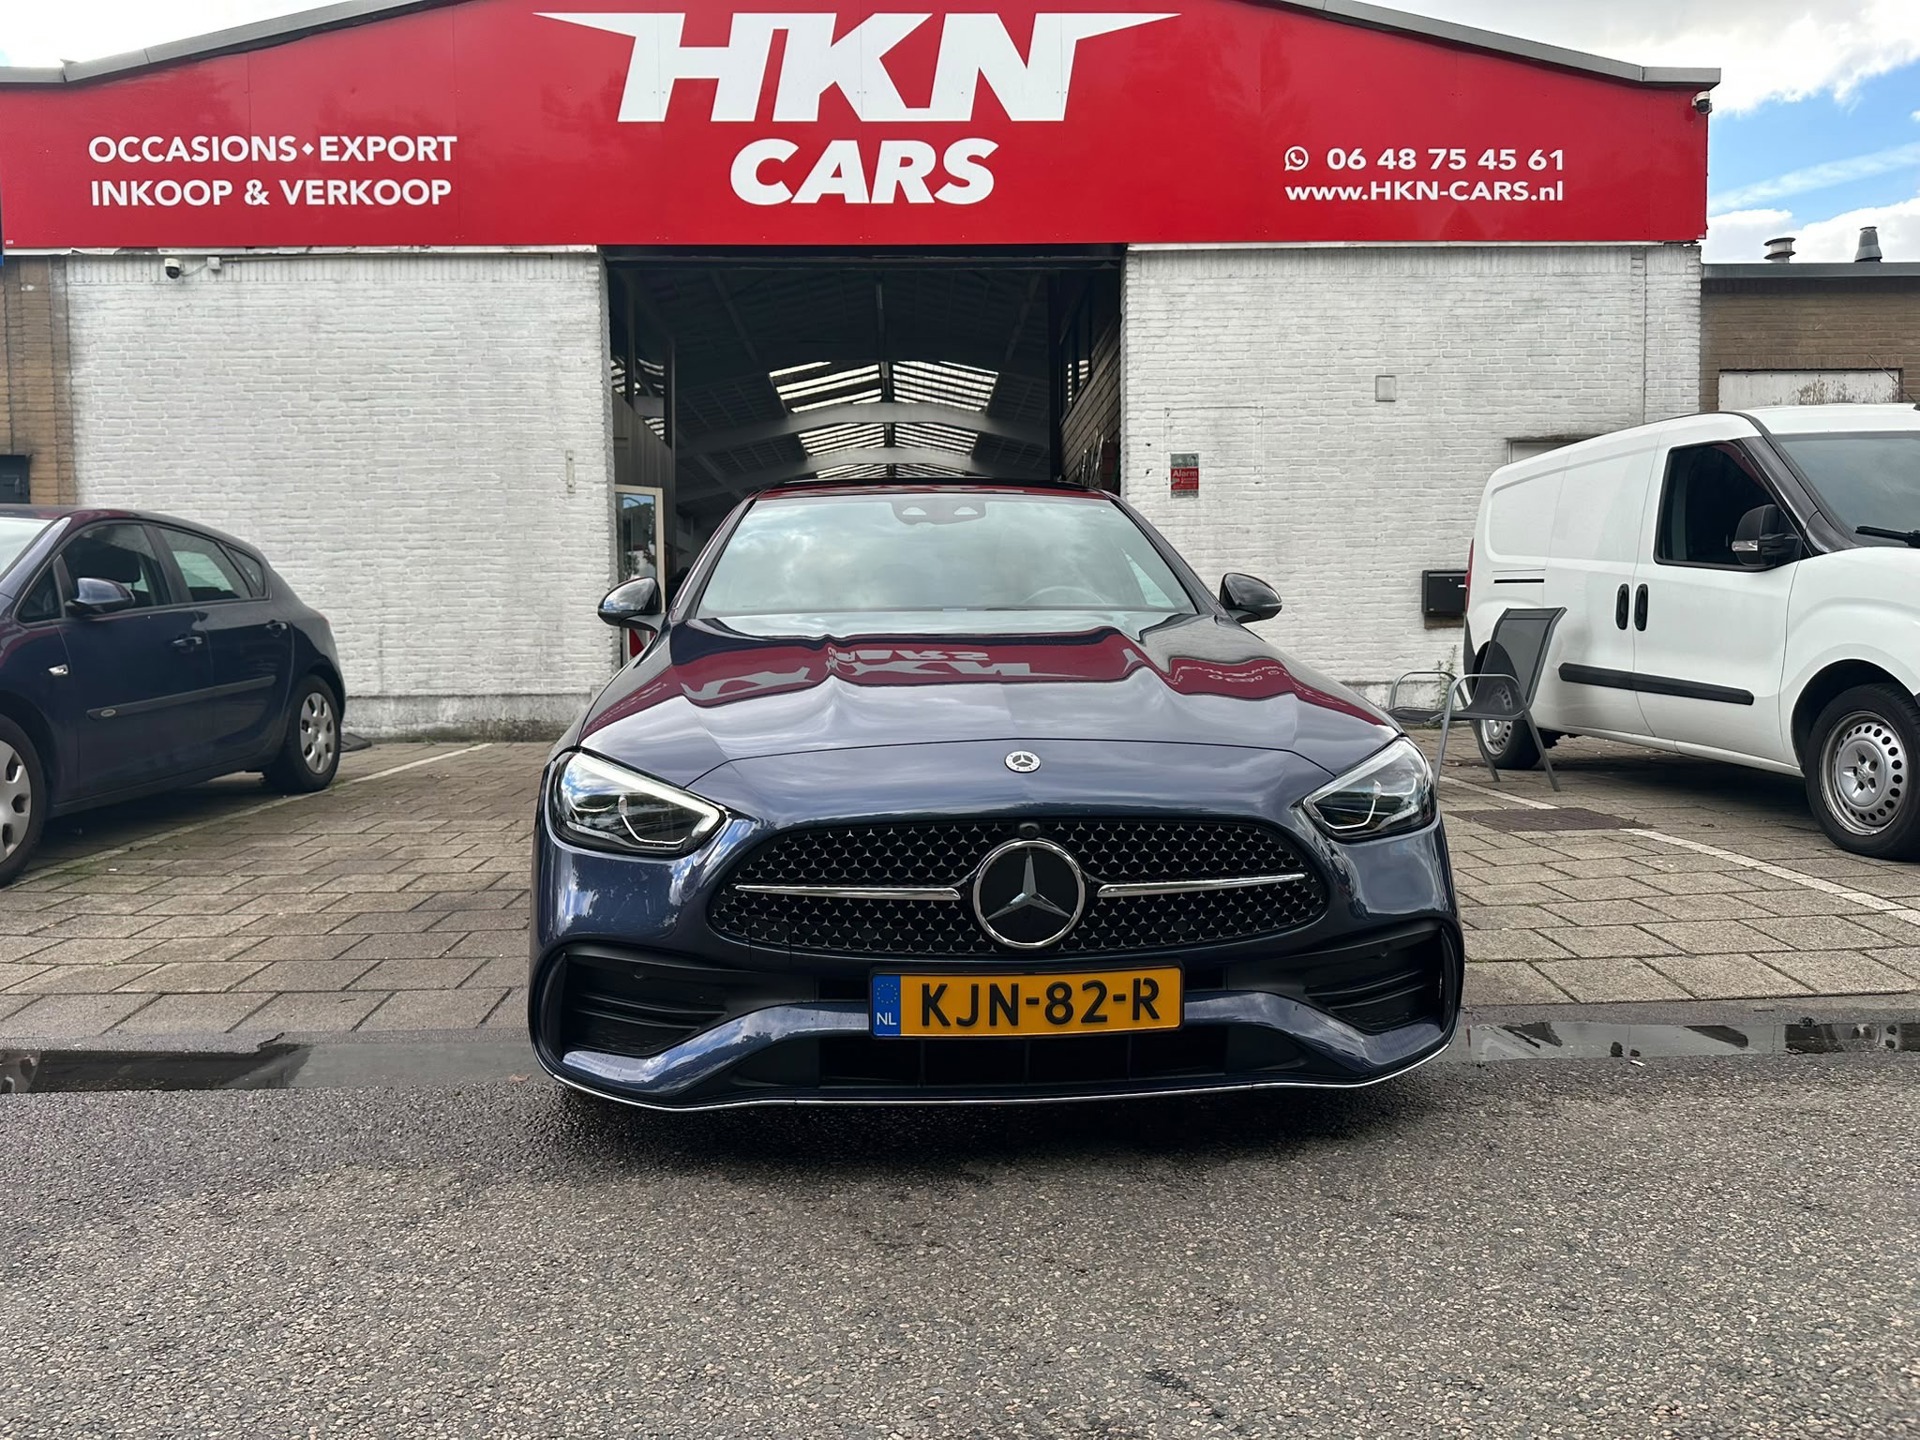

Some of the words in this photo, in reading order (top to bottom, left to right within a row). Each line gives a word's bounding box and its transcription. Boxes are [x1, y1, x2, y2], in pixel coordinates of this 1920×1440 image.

[533, 12, 1180, 123] HKN
[88, 135, 298, 163] OCCASIONS
[319, 135, 458, 163] EXPORT
[1326, 148, 1367, 170] 06
[1376, 148, 1417, 170] 48
[1427, 148, 1467, 170] 75
[1477, 149, 1517, 170] 45
[1527, 149, 1563, 171] 61
[730, 138, 999, 206] CARS
[91, 179, 233, 207] INKOOP
[244, 179, 270, 206] &
[279, 179, 452, 206] VERKOOP
[1285, 180, 1563, 201] www.HKN-CARS.nl
[1172, 469, 1197, 477] Alarm
[921, 977, 1161, 1027] KJN-82-R
[876, 1012, 897, 1026] NL
